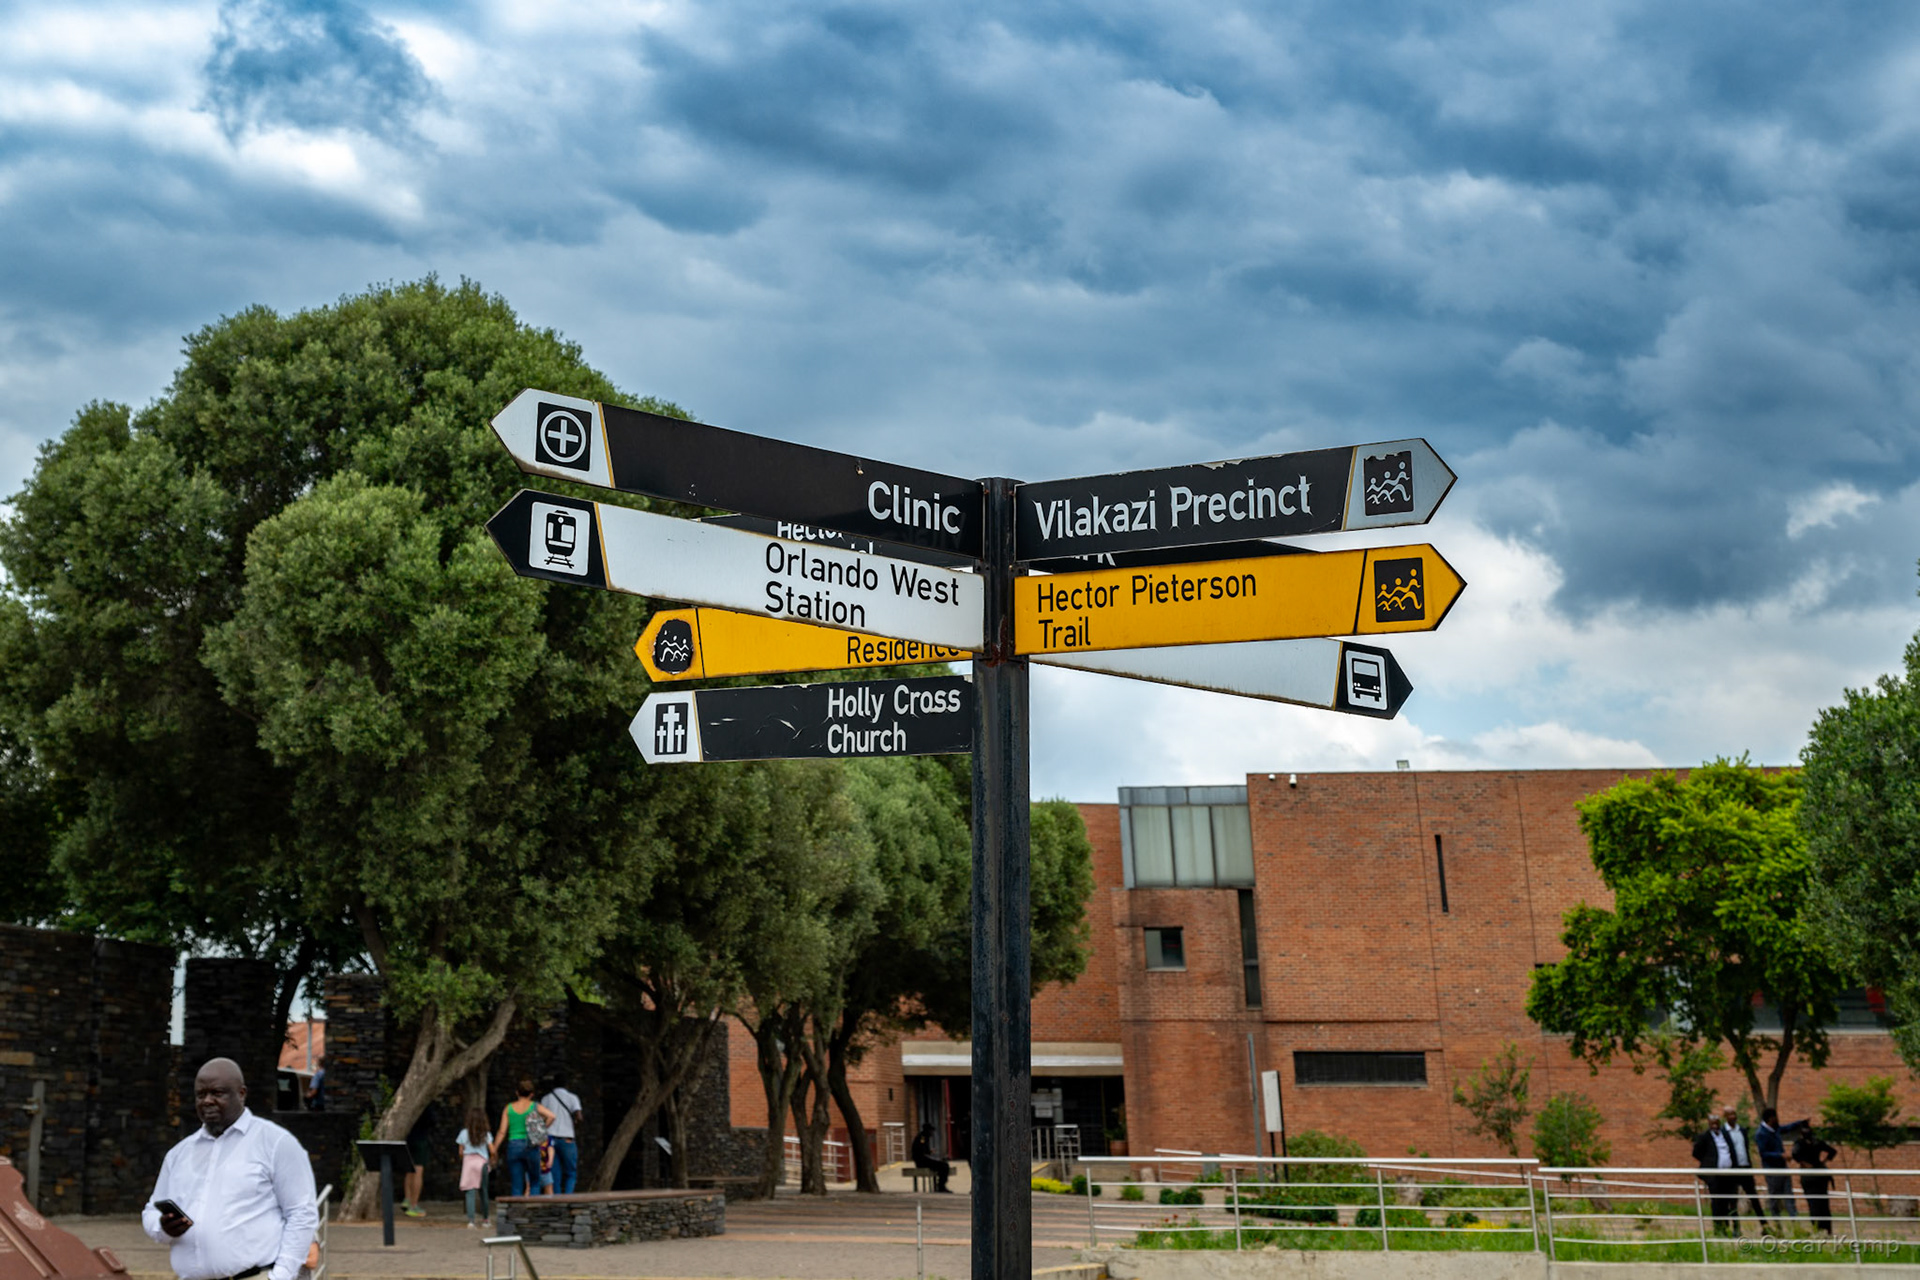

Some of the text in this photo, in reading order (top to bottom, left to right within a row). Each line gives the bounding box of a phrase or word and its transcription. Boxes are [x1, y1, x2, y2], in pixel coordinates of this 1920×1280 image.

[868, 480, 961, 534] Clinic
[1034, 475, 1312, 540] Vilakazi Precinct
[777, 521, 843, 541] Hec
[766, 542, 959, 606] Orlando West
[1037, 573, 1257, 613] Hector Pieterson
[765, 581, 865, 627] Station
[1038, 616, 1091, 648] Trail
[828, 684, 961, 723] Holly Cross
[827, 721, 907, 754] Church
